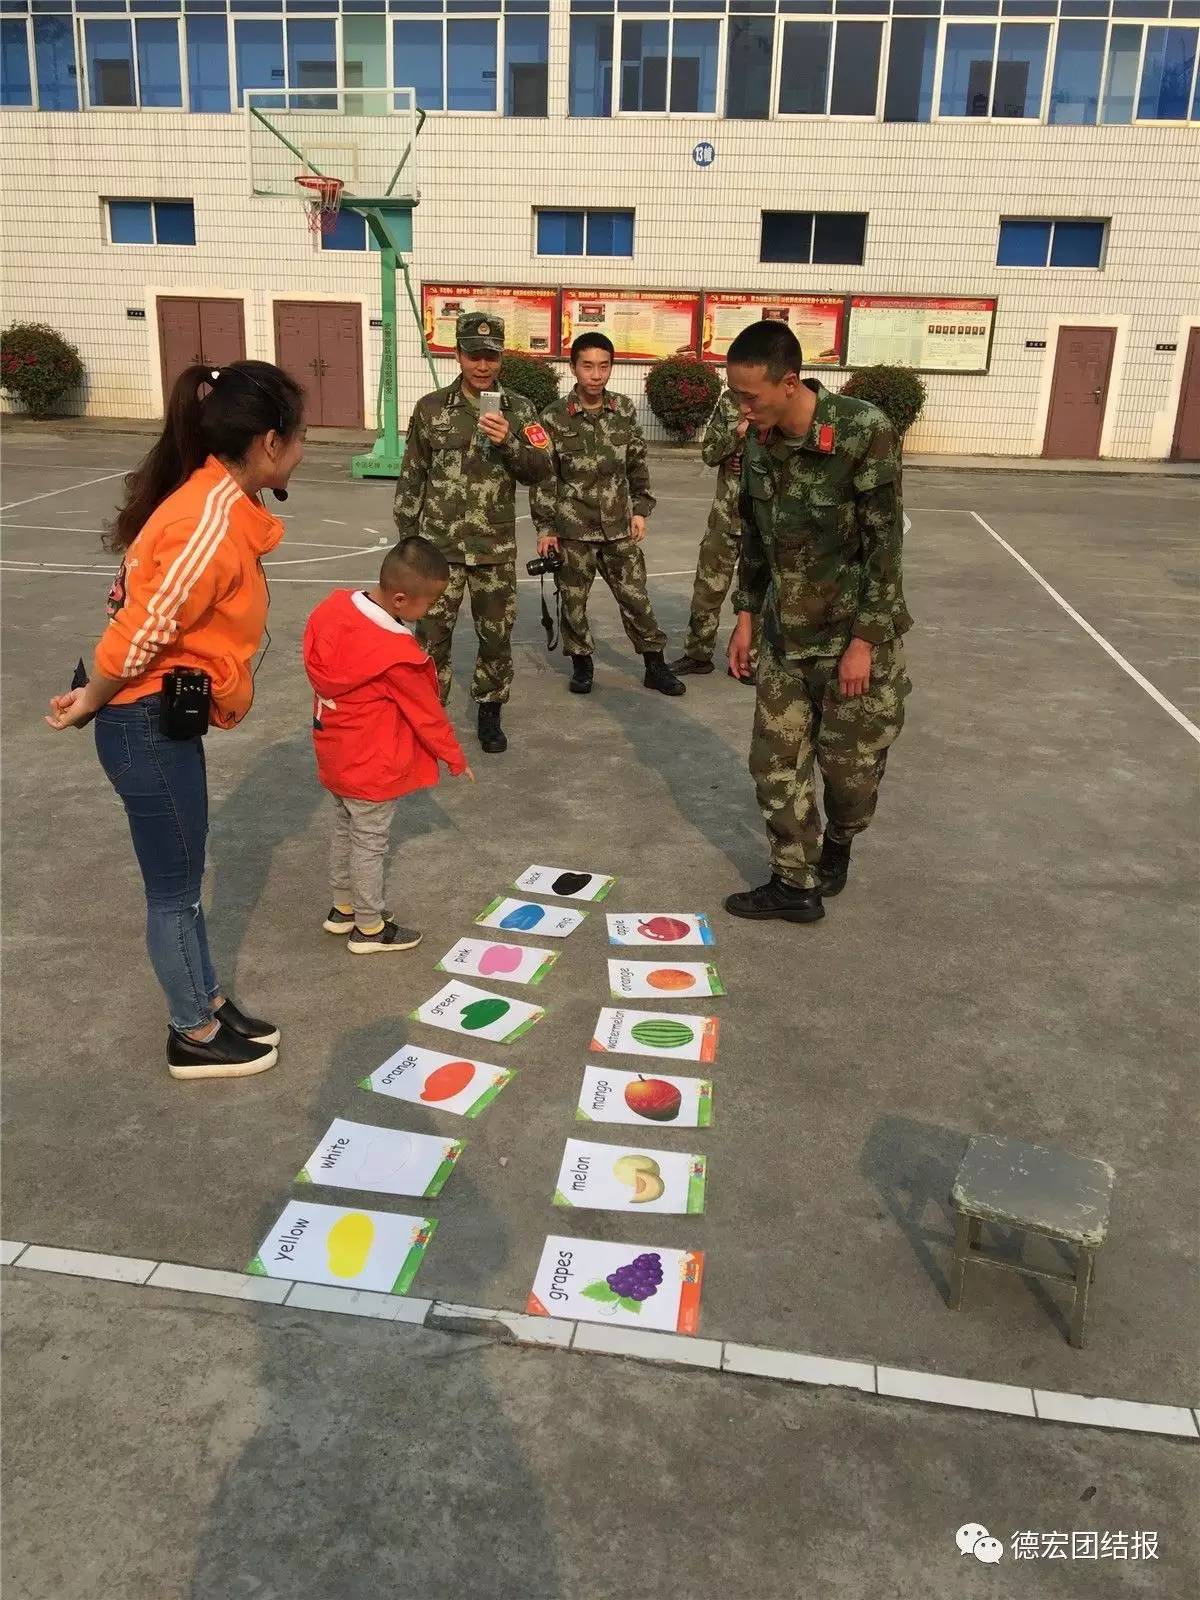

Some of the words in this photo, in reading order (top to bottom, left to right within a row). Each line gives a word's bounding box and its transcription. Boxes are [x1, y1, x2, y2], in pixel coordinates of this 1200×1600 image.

[556, 917, 576, 930] blue
[615, 920, 629, 936] apple
[454, 948, 472, 965] pink
[620, 967, 634, 992] orange
[431, 993, 460, 1016] green
[608, 1010, 625, 1049] watermelon
[381, 1055, 418, 1085] orange
[592, 1080, 612, 1110] mango
[320, 1137, 350, 1170] white
[570, 1156, 591, 1192] melon
[274, 1218, 310, 1261] yellow
[549, 1250, 574, 1301] grapes
